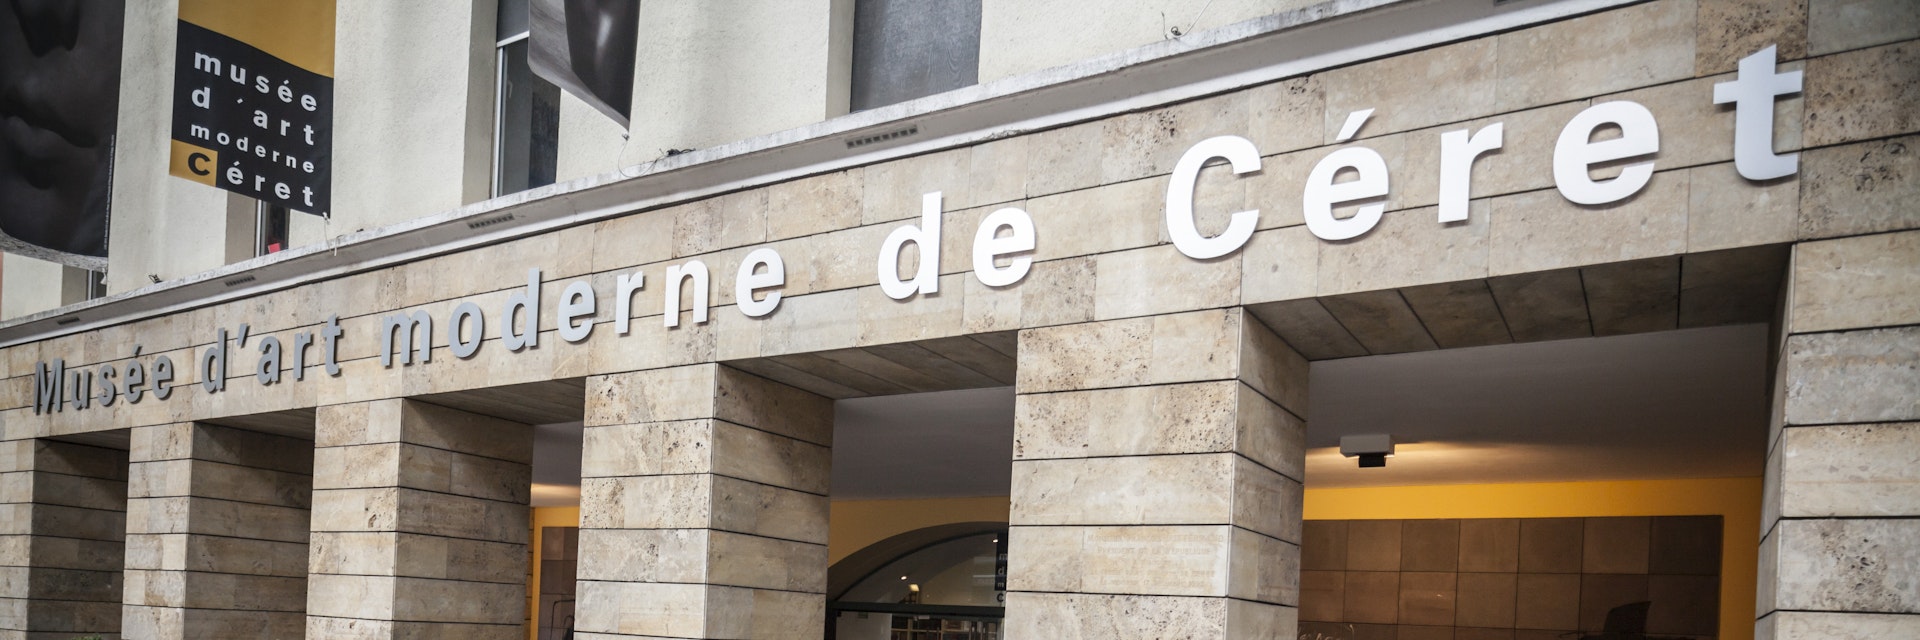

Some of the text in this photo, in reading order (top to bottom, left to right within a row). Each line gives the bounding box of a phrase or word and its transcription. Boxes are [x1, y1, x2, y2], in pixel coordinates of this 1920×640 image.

[194, 51, 317, 112] musée
[190, 123, 315, 173] moderne
[187, 152, 314, 207] Céret
[33, 43, 1804, 416] Musée d'art moderne de Céret
